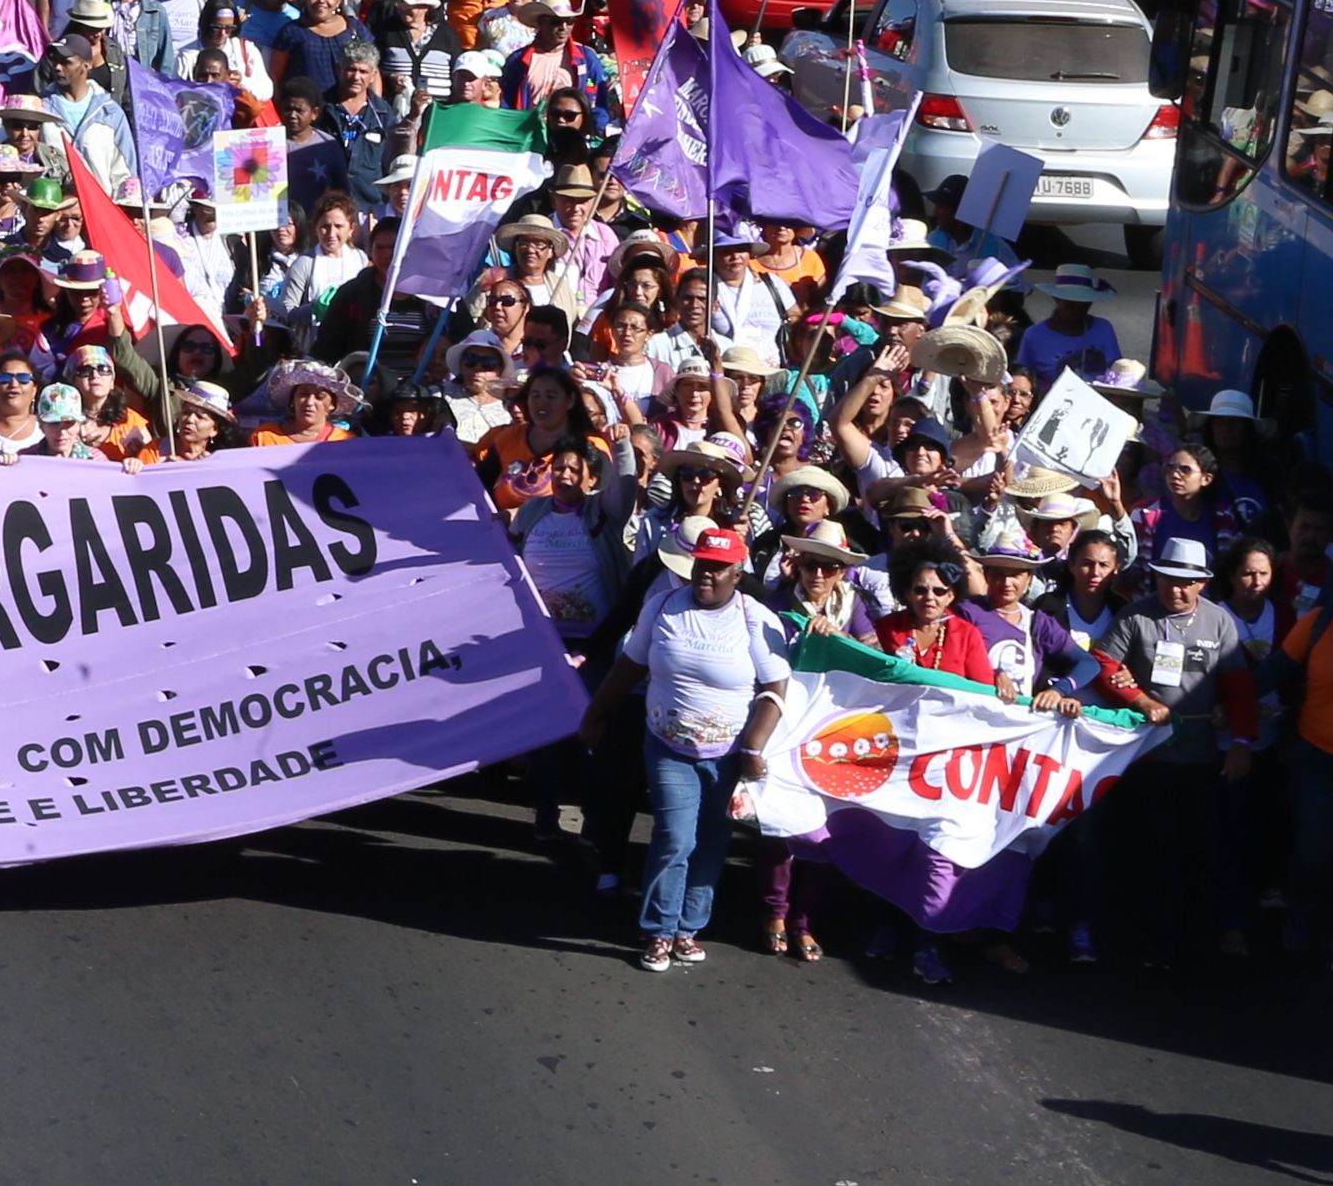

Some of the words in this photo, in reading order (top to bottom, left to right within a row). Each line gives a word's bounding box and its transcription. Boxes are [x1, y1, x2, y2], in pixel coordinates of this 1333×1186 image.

[15, 724, 126, 774] COM
[135, 637, 467, 753] DEMOCRACIA,
[30, 795, 63, 823] E
[73, 743, 343, 819] LIBERDADE
